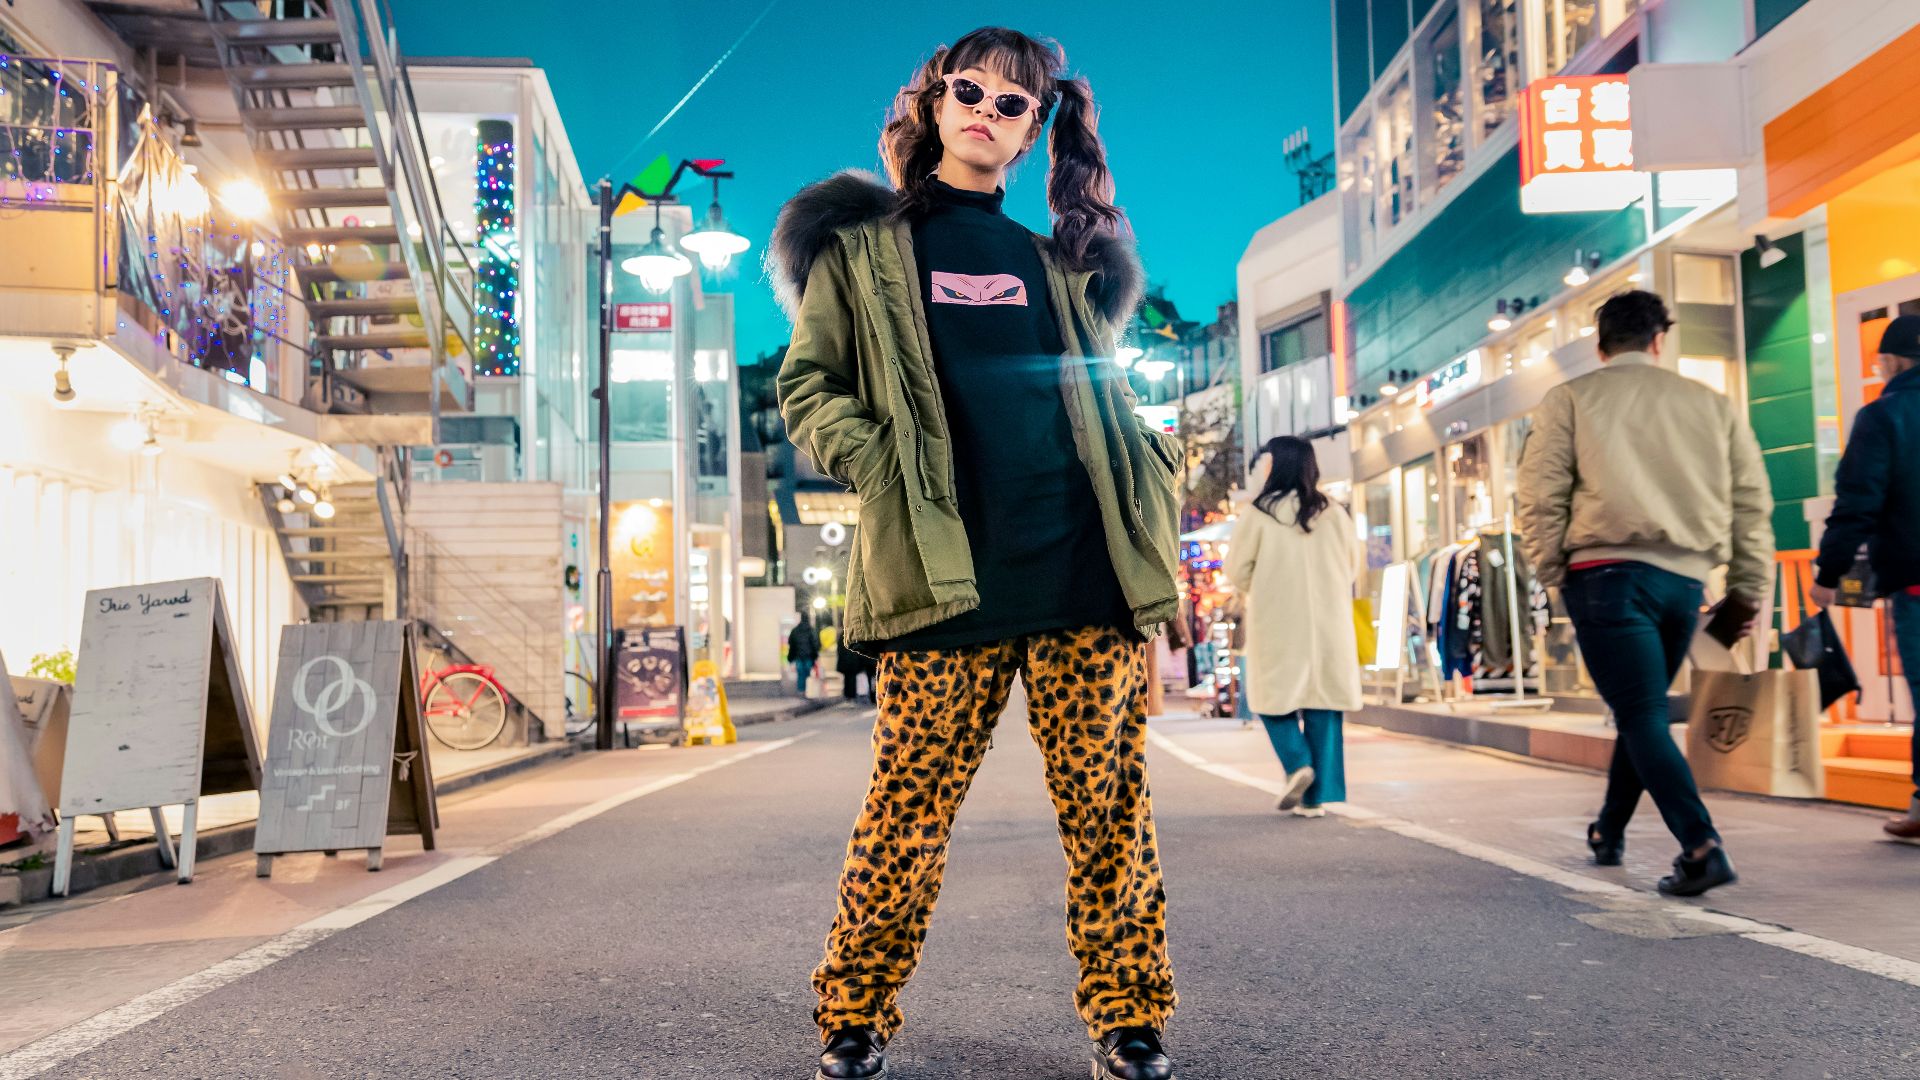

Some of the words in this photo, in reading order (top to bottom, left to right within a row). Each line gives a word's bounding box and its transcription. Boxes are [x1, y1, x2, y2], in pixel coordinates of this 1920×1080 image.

[273, 768, 307, 777] Vintage
[317, 767, 341, 775] Used
[342, 764, 380, 775] Clothing
